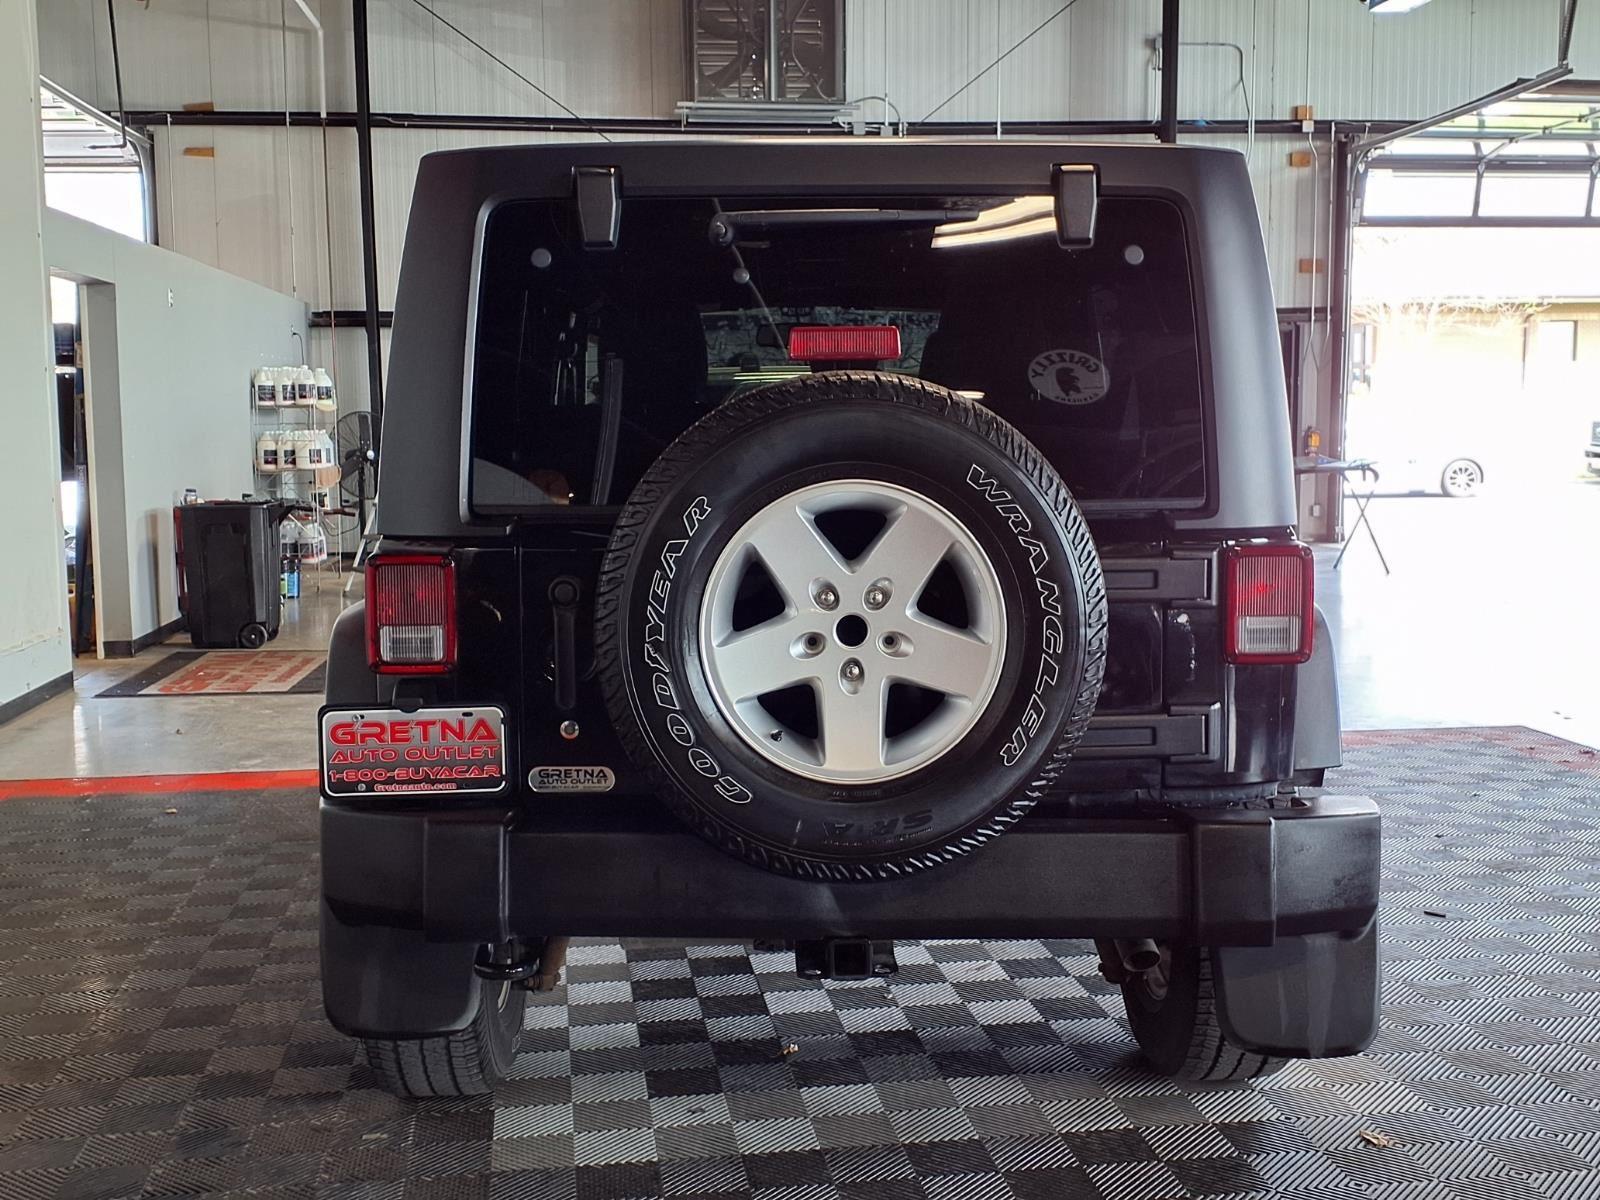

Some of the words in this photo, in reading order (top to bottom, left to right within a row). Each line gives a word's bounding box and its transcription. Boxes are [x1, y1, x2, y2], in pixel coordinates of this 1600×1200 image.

[966, 463, 1064, 767] WRANGLER
[645, 496, 753, 804] GOODYEAR
[329, 718, 499, 746] GRETNA
[329, 747, 398, 764] AUTO
[405, 744, 501, 761] OUTLET
[328, 764, 501, 783] 1-800-BUYACAR
[538, 768, 608, 779] GRETNA
[373, 781, 457, 792] Gretnaauto.com
